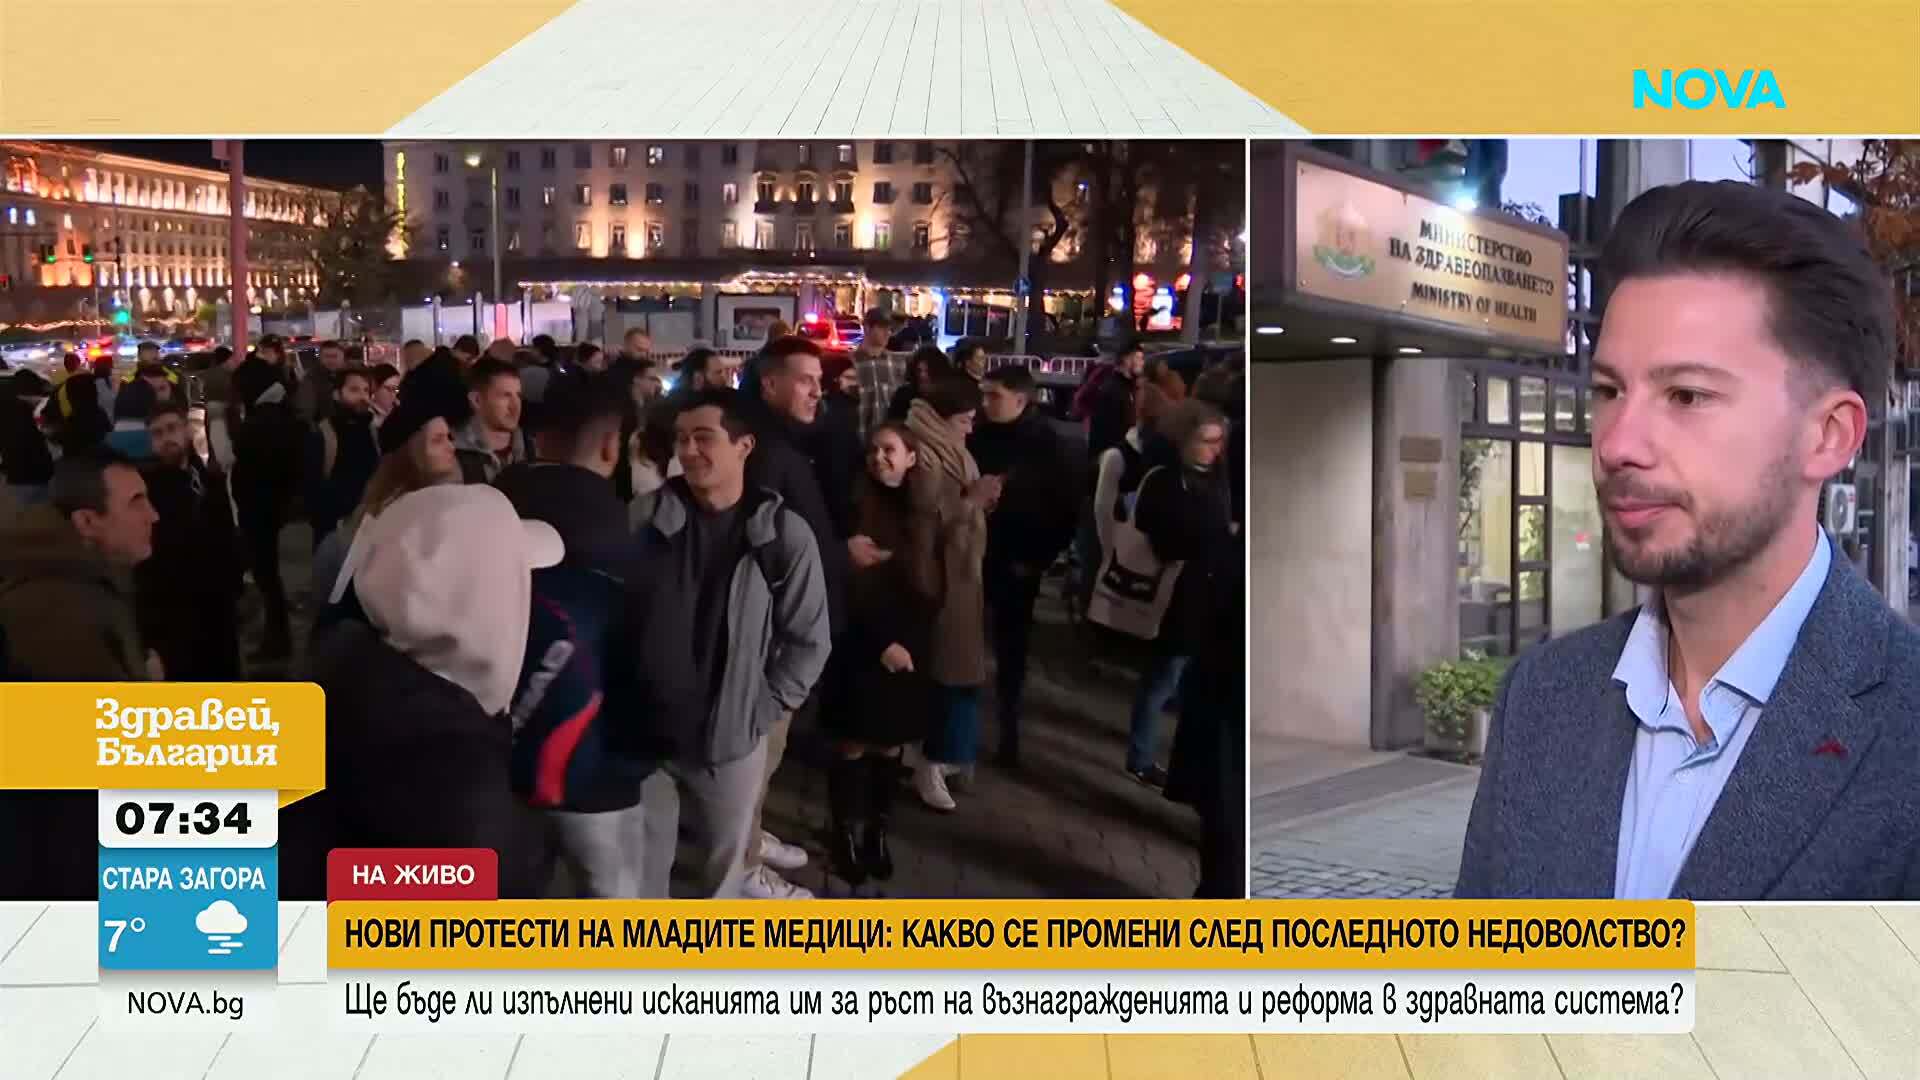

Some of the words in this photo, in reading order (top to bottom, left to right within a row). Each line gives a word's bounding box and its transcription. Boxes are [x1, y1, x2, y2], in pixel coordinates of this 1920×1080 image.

[1389, 237, 1412, 262] НА
[1415, 245, 1555, 297] ЗДРАВЕОПАЗВАНЕТО
[1411, 281, 1473, 313] MINISTRY
[1476, 295, 1490, 314] OF
[1495, 297, 1538, 323] HEALTH
